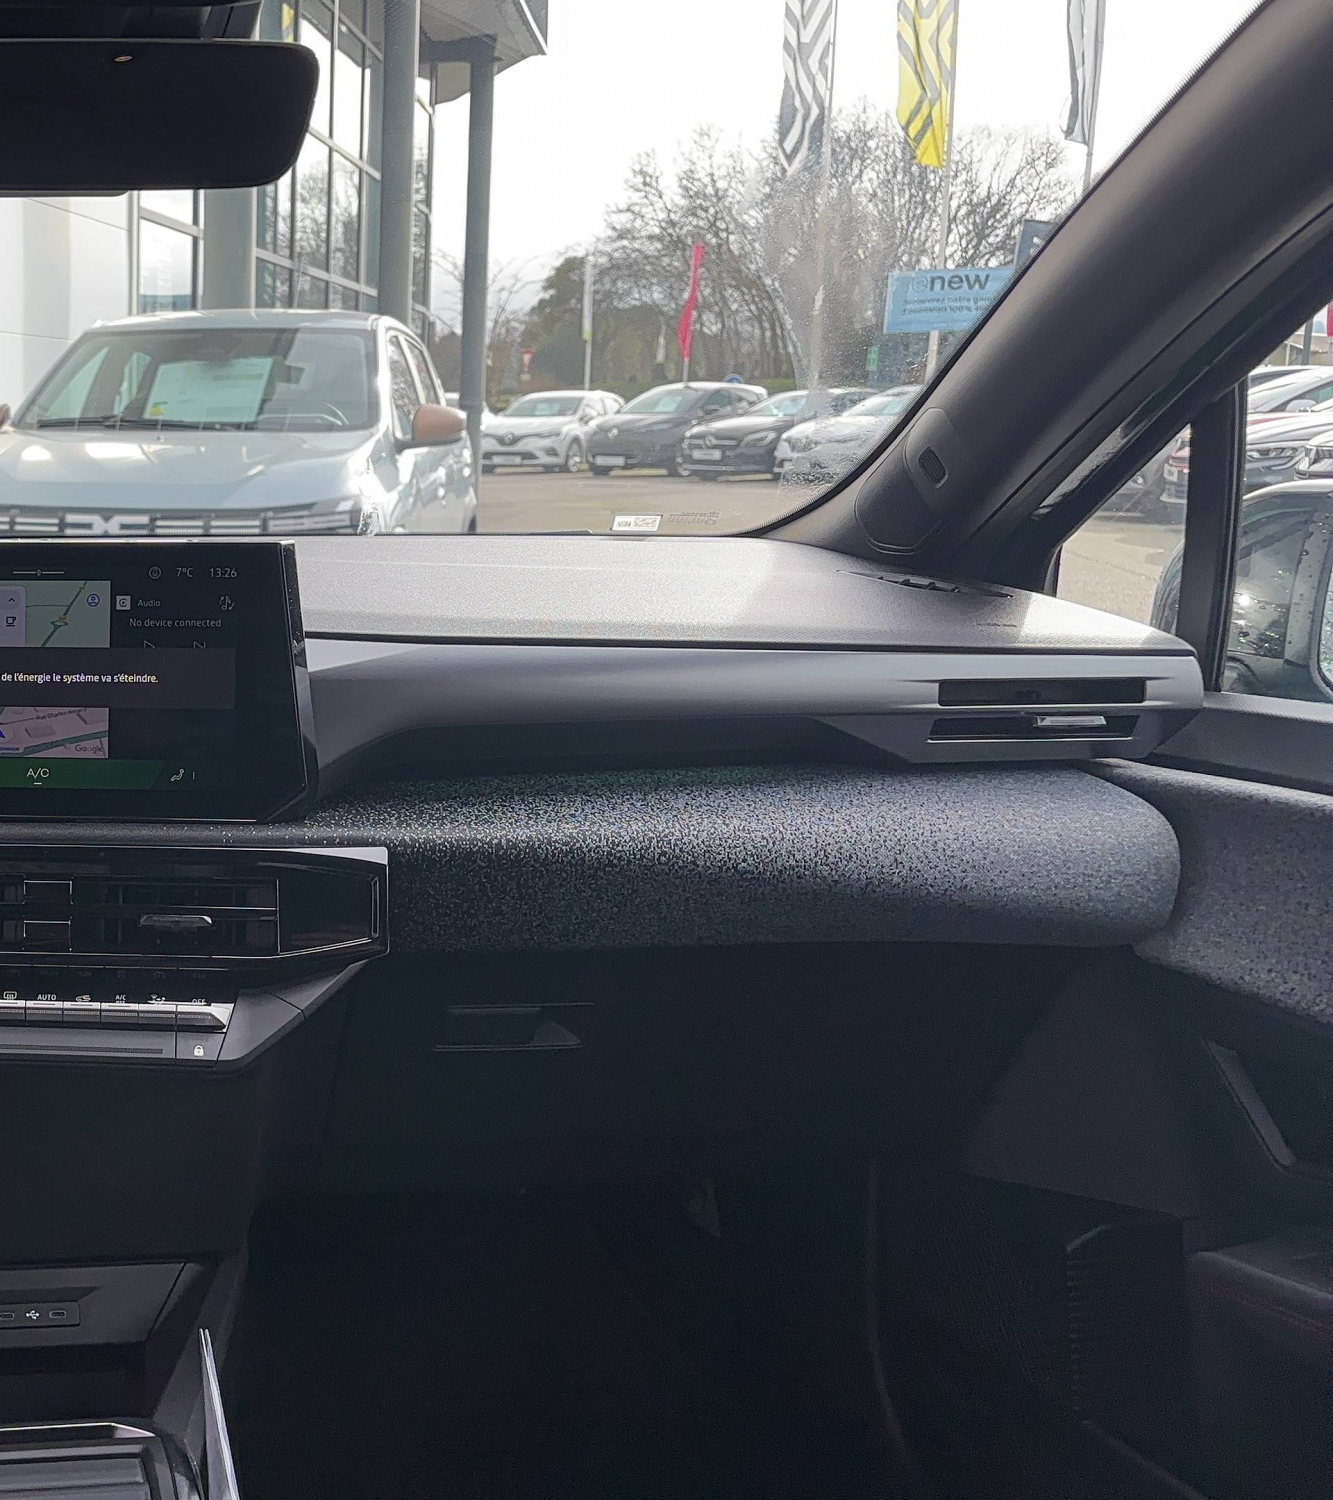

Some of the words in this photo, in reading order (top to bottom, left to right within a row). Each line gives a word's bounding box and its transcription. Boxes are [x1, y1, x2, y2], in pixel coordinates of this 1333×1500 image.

[176, 568, 193, 577] 7°C
[209, 568, 237, 578] 13:26
[137, 599, 161, 607] Audio
[129, 618, 142, 627] No
[144, 618, 172, 627] device
[174, 618, 222, 628] connected
[1, 672, 12, 681] de
[14, 672, 51, 684] l'énergie
[53, 673, 61, 682] le
[63, 673, 100, 684] système
[101, 675, 112, 683] va
[114, 673, 159, 683] s'éteindre.
[27, 768, 50, 779] A/C
